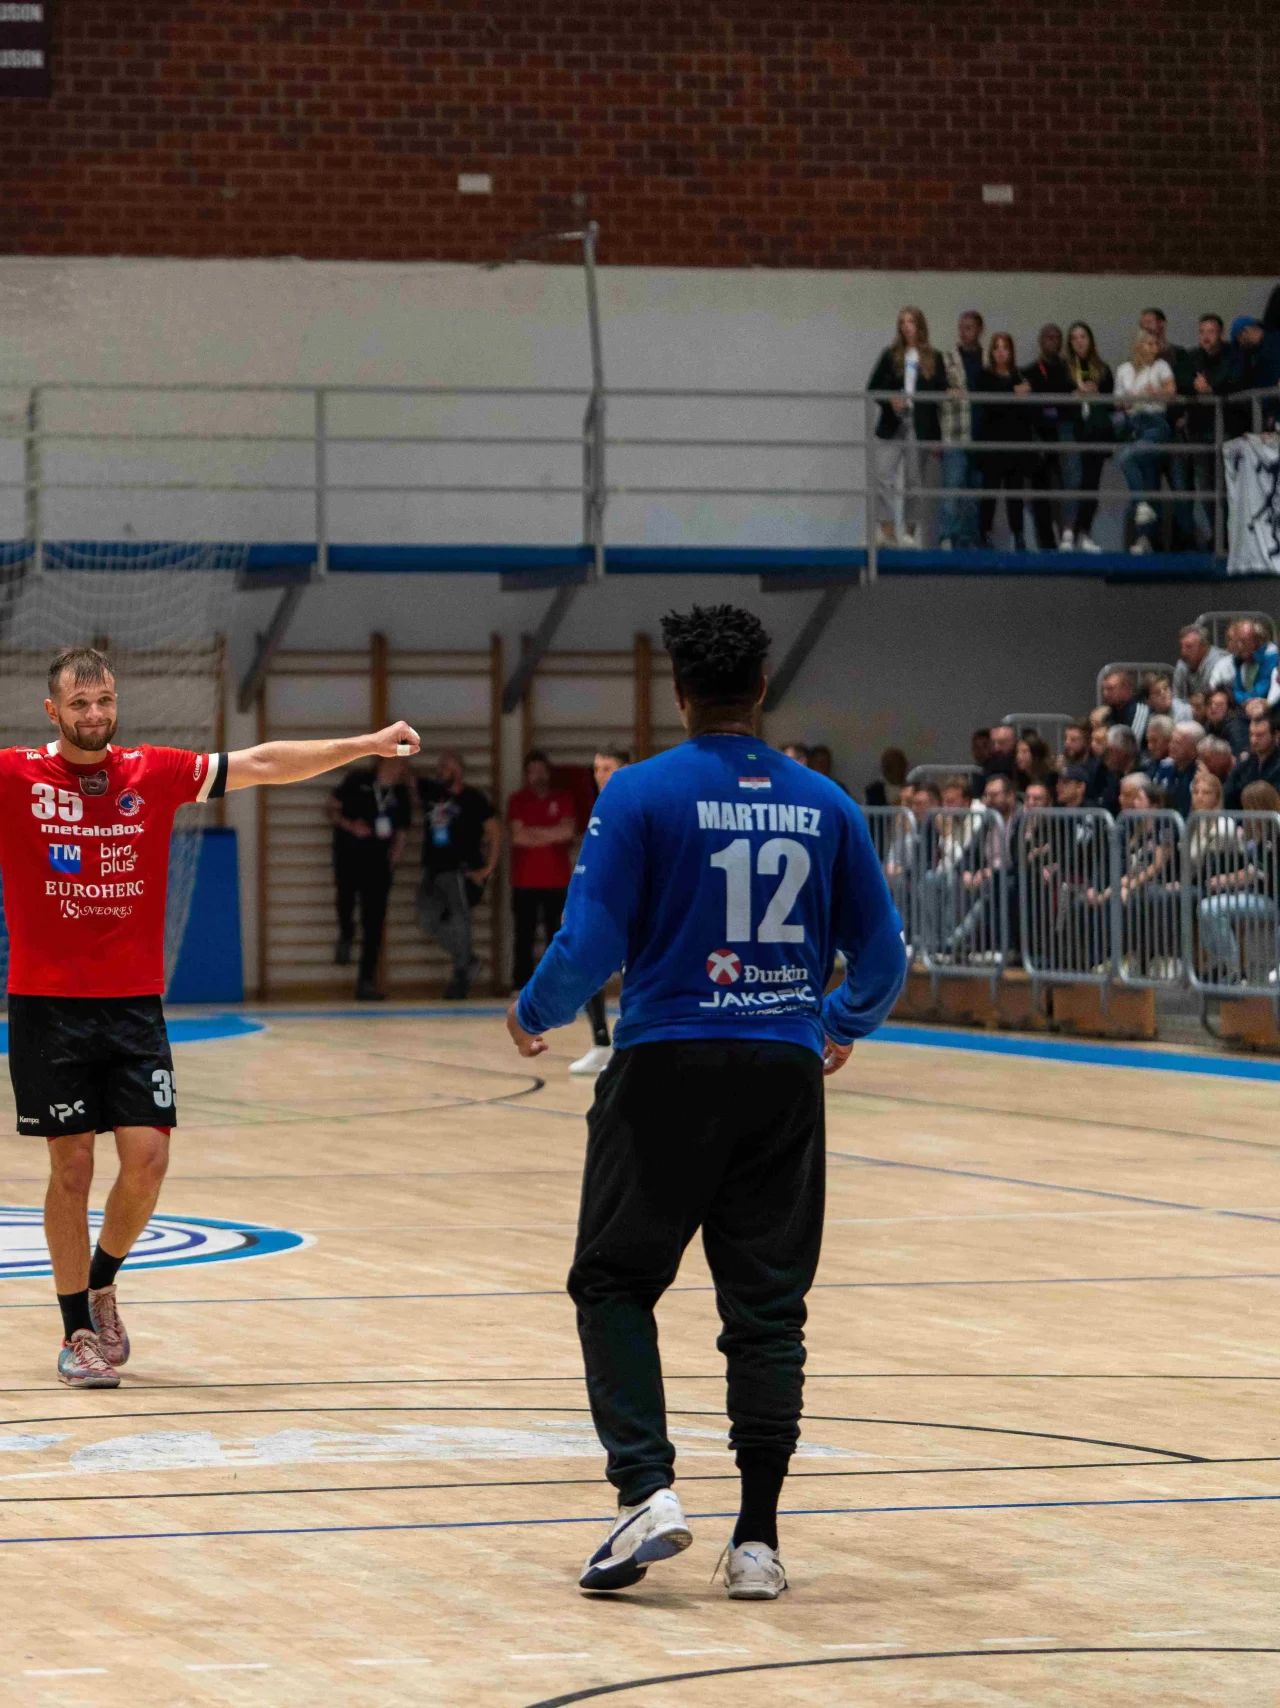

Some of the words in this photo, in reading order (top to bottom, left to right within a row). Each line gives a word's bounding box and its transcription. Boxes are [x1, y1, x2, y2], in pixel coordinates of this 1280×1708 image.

[31, 782, 83, 822] 35
[696, 801, 821, 837] MARTINEZ
[40, 823, 144, 837] metaloBox
[49, 843, 81, 860] TM
[100, 842, 132, 859] biro
[100, 857, 135, 877] plus
[45, 880, 145, 898] EUROHERC
[710, 837, 811, 943] 12
[744, 964, 809, 983] Đurkin
[151, 1068, 177, 1108] 3
